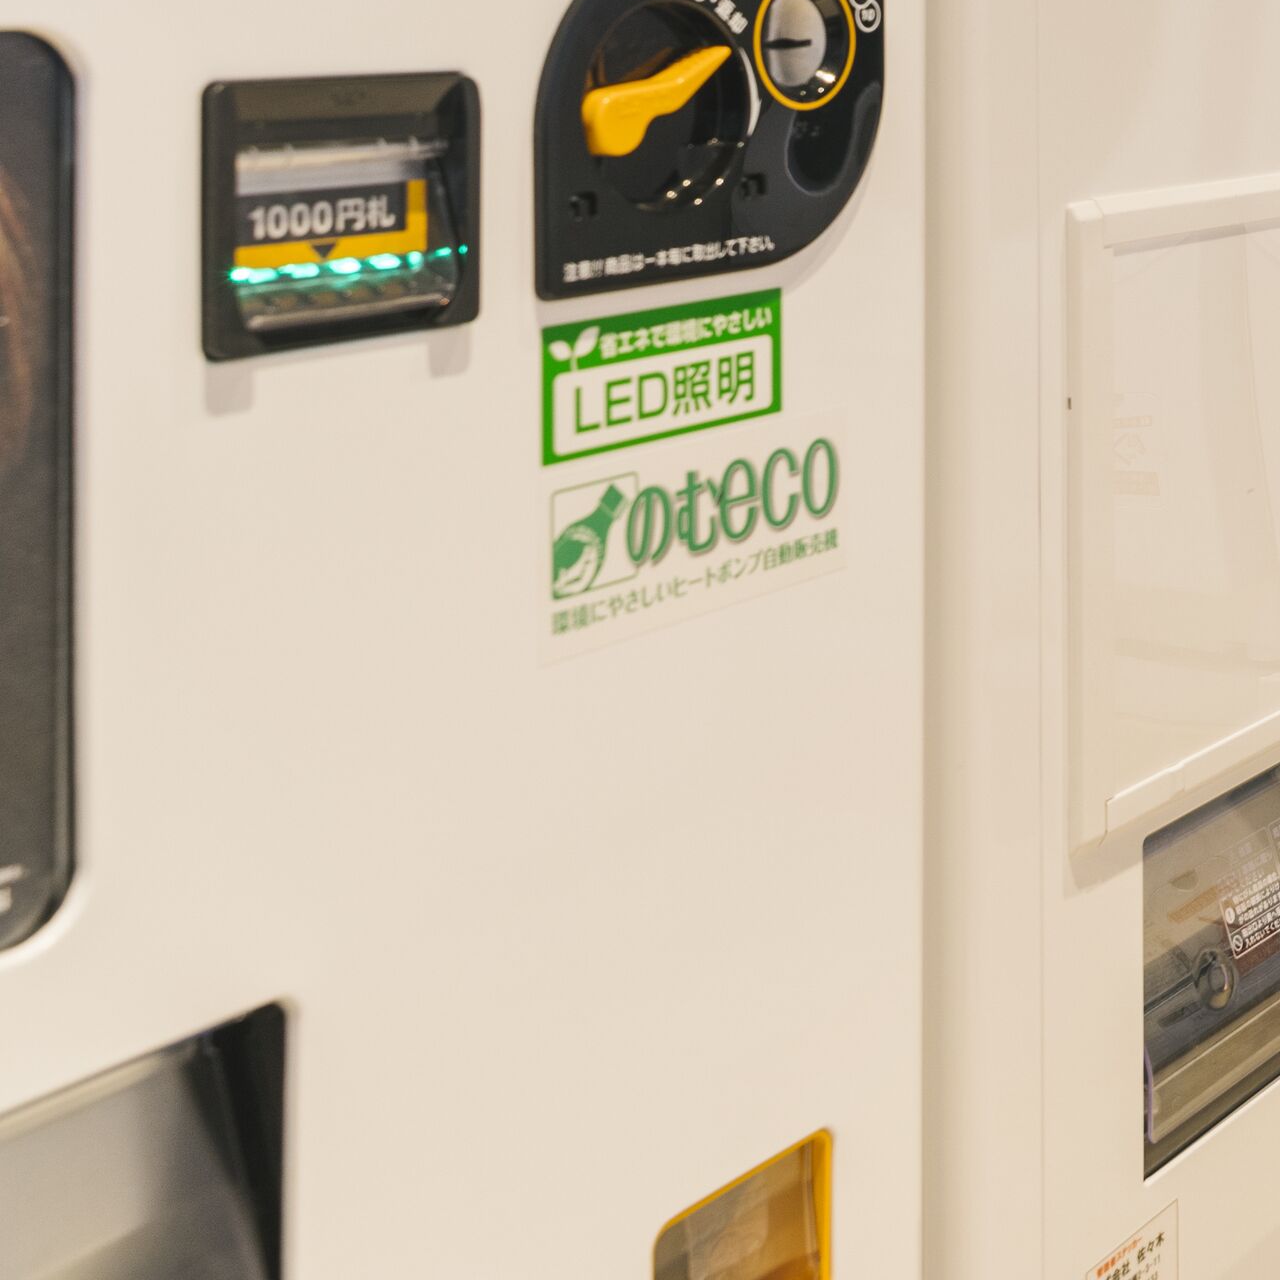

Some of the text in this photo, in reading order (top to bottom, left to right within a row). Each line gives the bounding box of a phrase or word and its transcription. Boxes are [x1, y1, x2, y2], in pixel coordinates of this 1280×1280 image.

[248, 195, 397, 241] 1000円札
[600, 306, 773, 359] 省エネで環境にやさしい
[575, 350, 756, 435] LED照明
[625, 436, 840, 566] のむeco
[552, 528, 839, 636] 環境にやさしいヒートポンプ自動販売機
